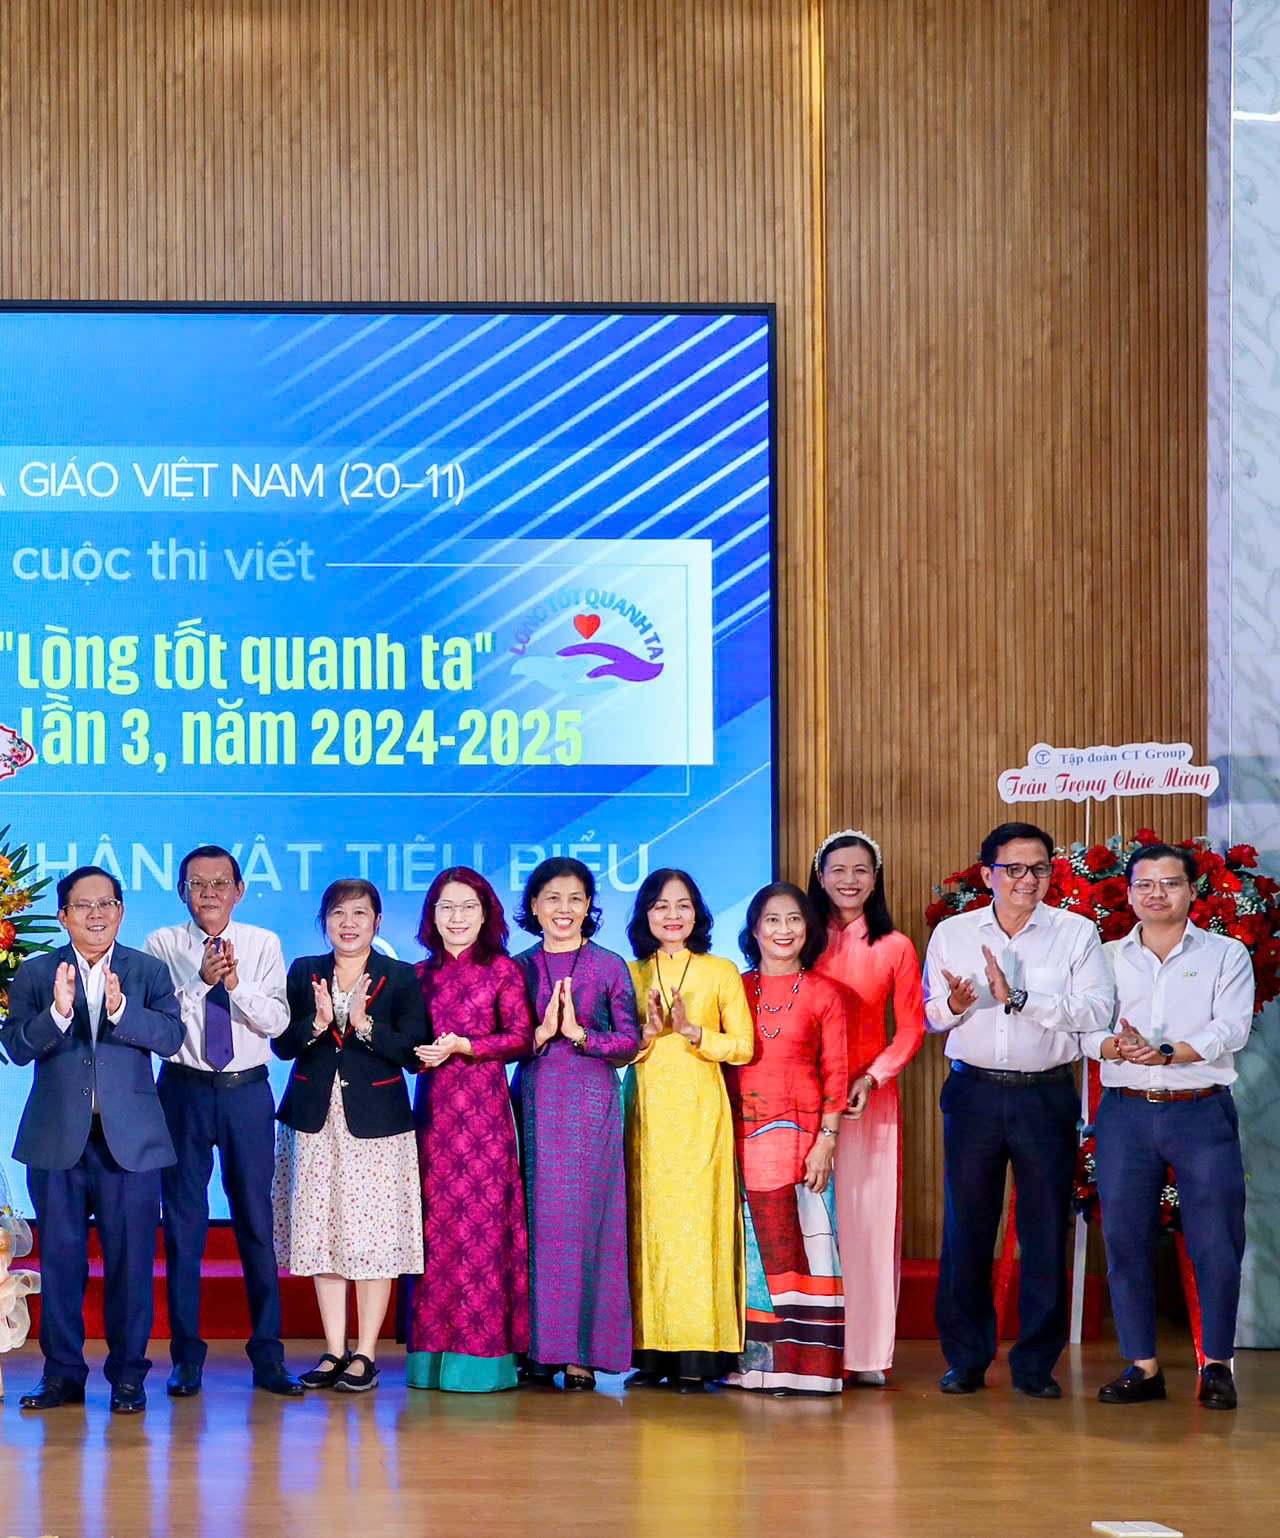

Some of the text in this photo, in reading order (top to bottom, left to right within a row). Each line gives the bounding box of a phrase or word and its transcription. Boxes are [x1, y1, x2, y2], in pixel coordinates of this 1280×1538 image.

[19, 455, 119, 499] GIÁO
[132, 456, 219, 501] VIỆT
[231, 462, 323, 498] NAM
[12, 540, 131, 587] cuộc
[146, 538, 208, 582] thi
[223, 538, 316, 582] viết
[153, 618, 228, 691] tốt
[240, 634, 406, 695] quanh
[420, 631, 493, 691] ta"
[121, 706, 167, 773] 3,
[181, 698, 295, 765] năm
[310, 706, 583, 766] 2024-2025
[1060, 748, 1187, 766] Tập đoàn CT Group
[1005, 767, 1211, 796] Trân Trọng Chúc Mừng
[509, 829, 648, 893] BỂU
